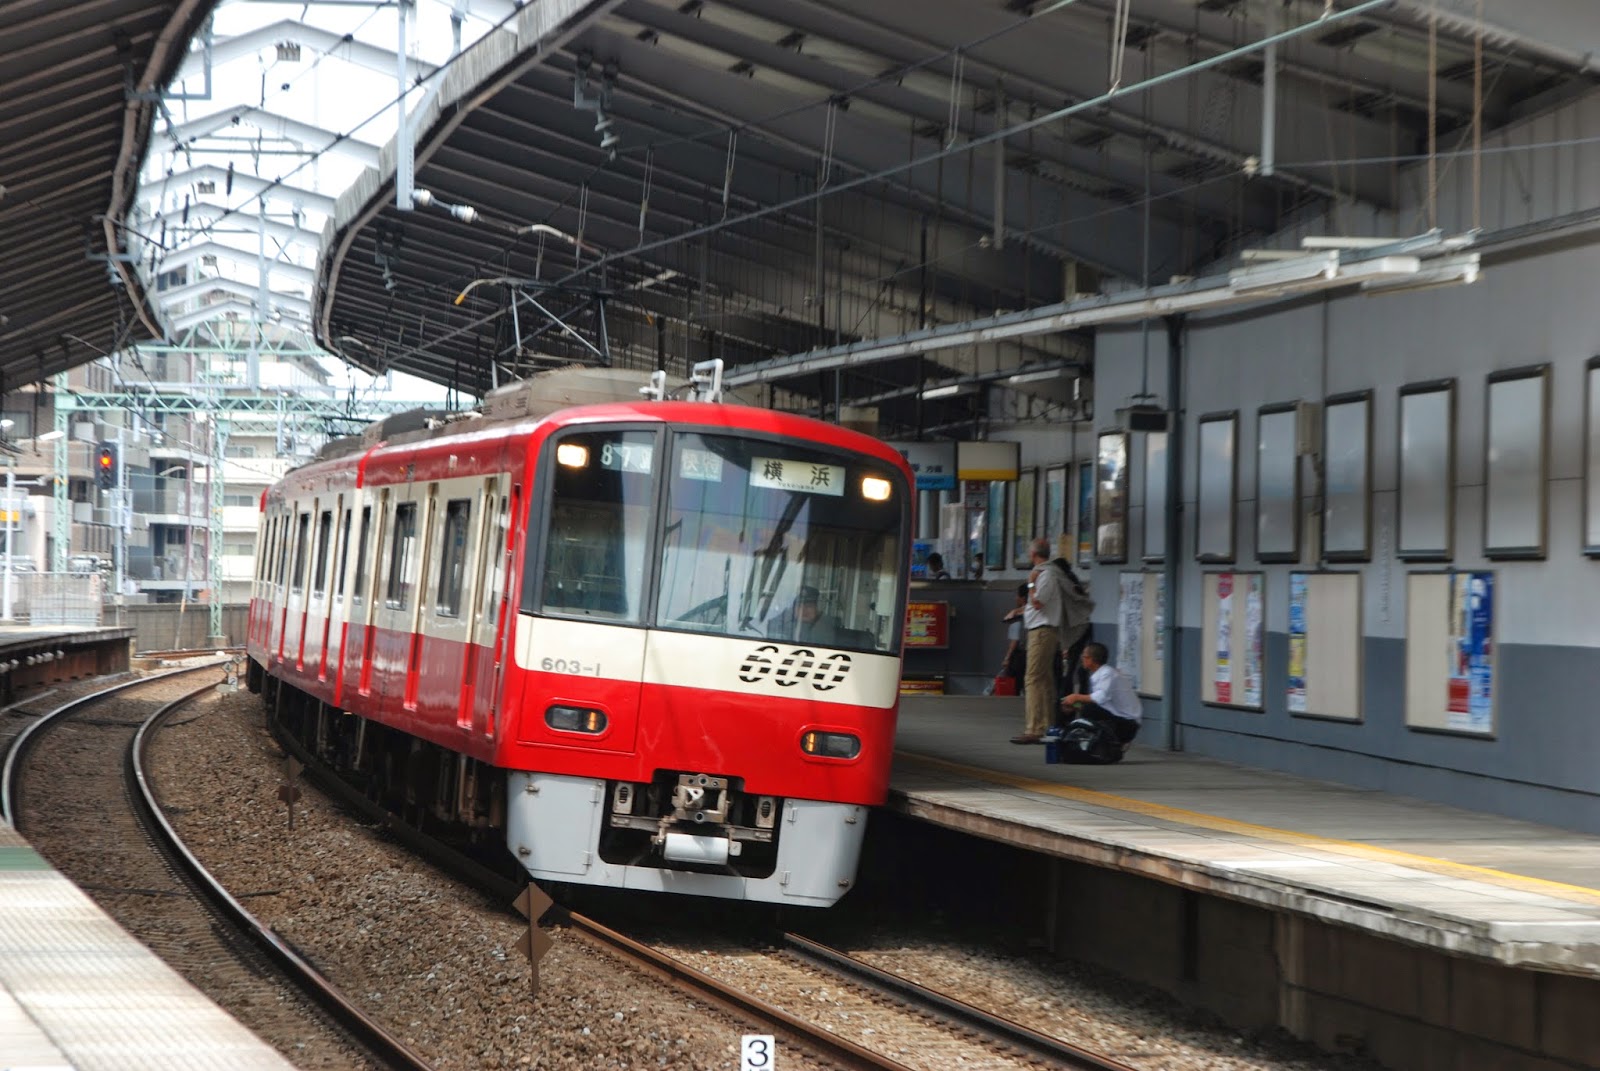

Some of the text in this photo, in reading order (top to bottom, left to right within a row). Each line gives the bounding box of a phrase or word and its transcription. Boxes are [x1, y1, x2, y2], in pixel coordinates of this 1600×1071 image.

[763, 460, 830, 487] 横浜
[541, 657, 601, 677] 603-1
[738, 645, 852, 691] 600
[747, 1039, 769, 1067] 3
